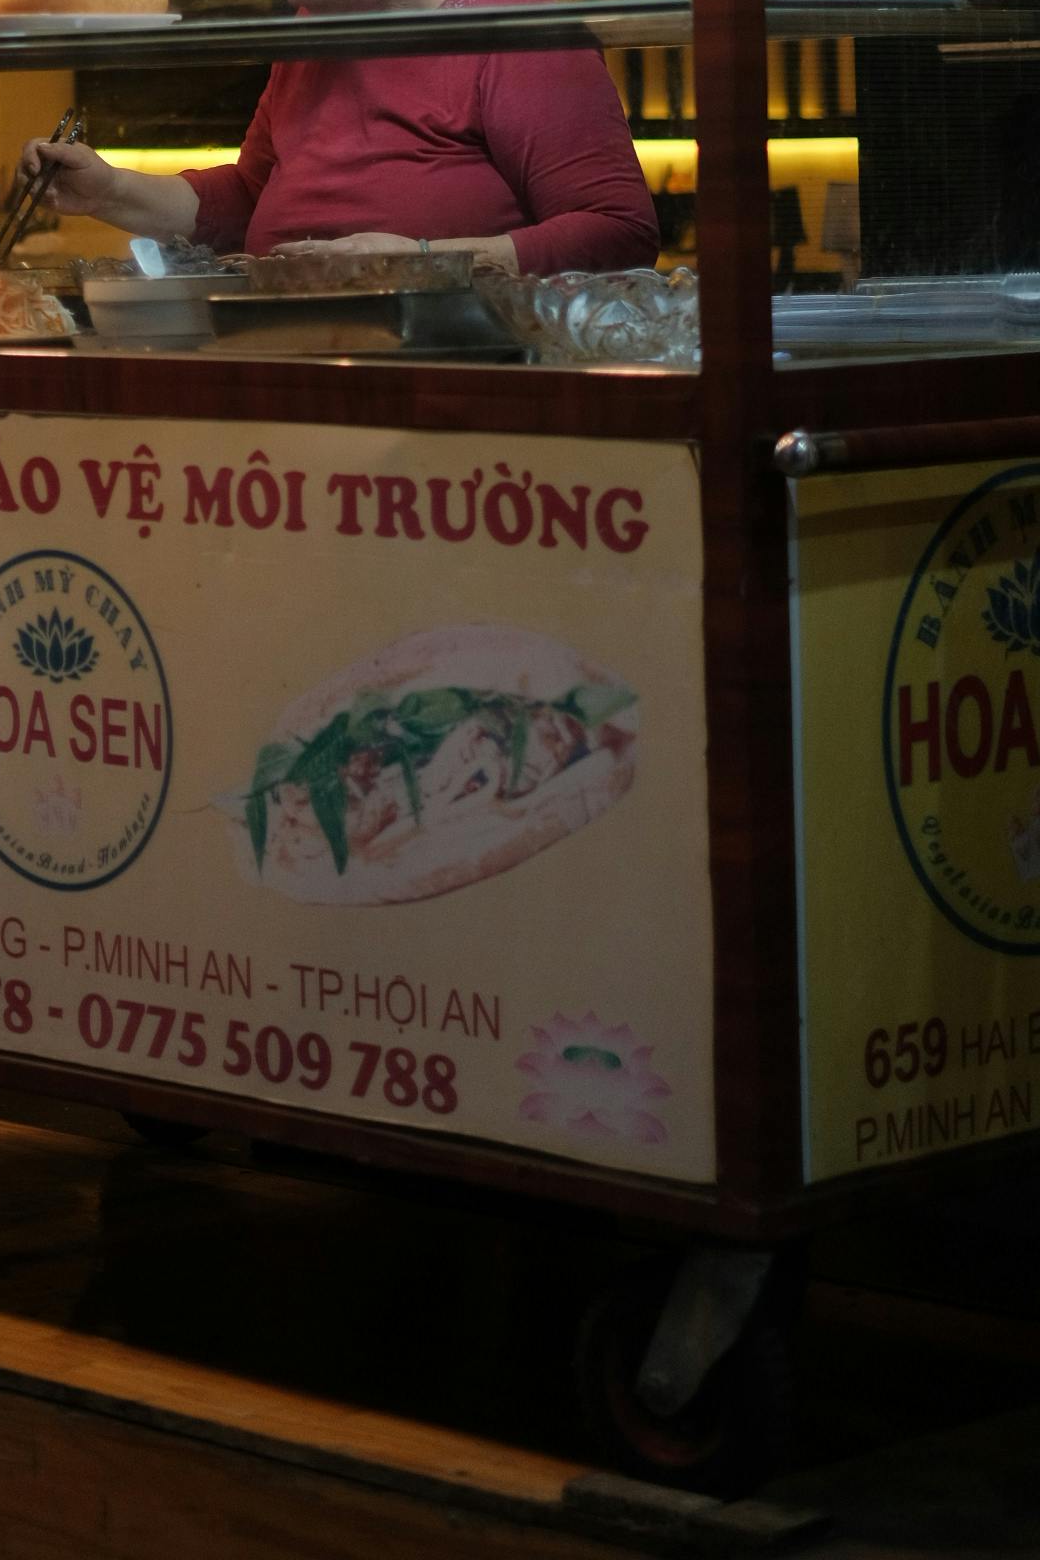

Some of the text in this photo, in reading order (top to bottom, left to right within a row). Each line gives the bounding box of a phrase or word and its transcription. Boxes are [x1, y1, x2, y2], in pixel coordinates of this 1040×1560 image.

[78, 443, 165, 539] VỆ
[182, 448, 307, 533] MÔI
[326, 461, 650, 554] TRƯỜNG
[84, 583, 149, 673] CHAY
[68, 693, 163, 772] SEN
[897, 668, 1040, 788] HOA
[63, 924, 191, 989] P.MINH
[199, 949, 253, 1001] AN
[289, 962, 429, 1035] TP.HỘI
[440, 987, 502, 1041] AN
[77, 992, 208, 1068] 0775
[221, 1018, 333, 1091] 509
[348, 1040, 460, 1115] 788
[864, 1016, 948, 1089] 659
[961, 1016, 1016, 1070] HAI
[854, 1081, 1033, 1163] P.MINH AN
